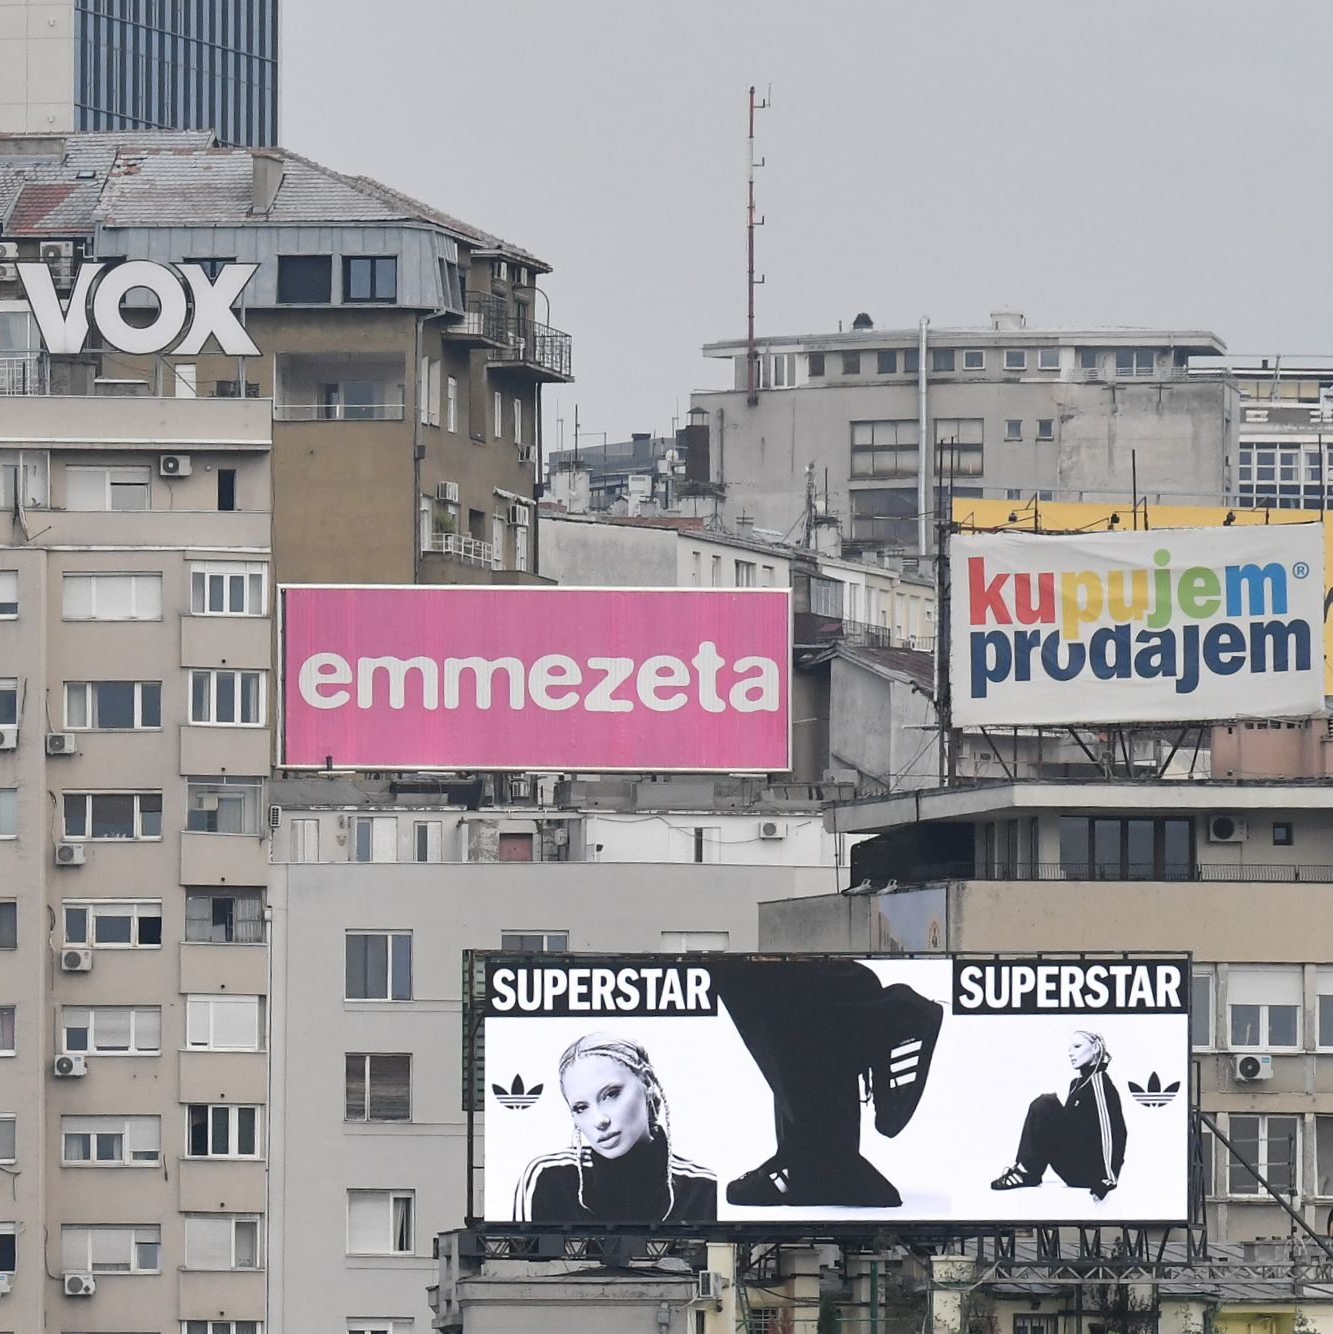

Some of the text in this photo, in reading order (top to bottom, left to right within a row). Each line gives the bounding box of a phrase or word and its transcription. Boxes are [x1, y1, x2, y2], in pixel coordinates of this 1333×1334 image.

[18, 260, 263, 356] VOX
[968, 549, 1287, 640] kupujem
[299, 641, 780, 712] emmezeta
[970, 618, 1311, 699] prodajem
[491, 967, 712, 1011] SUPERSTAR
[958, 965, 1182, 1009] SUPERSTAR
